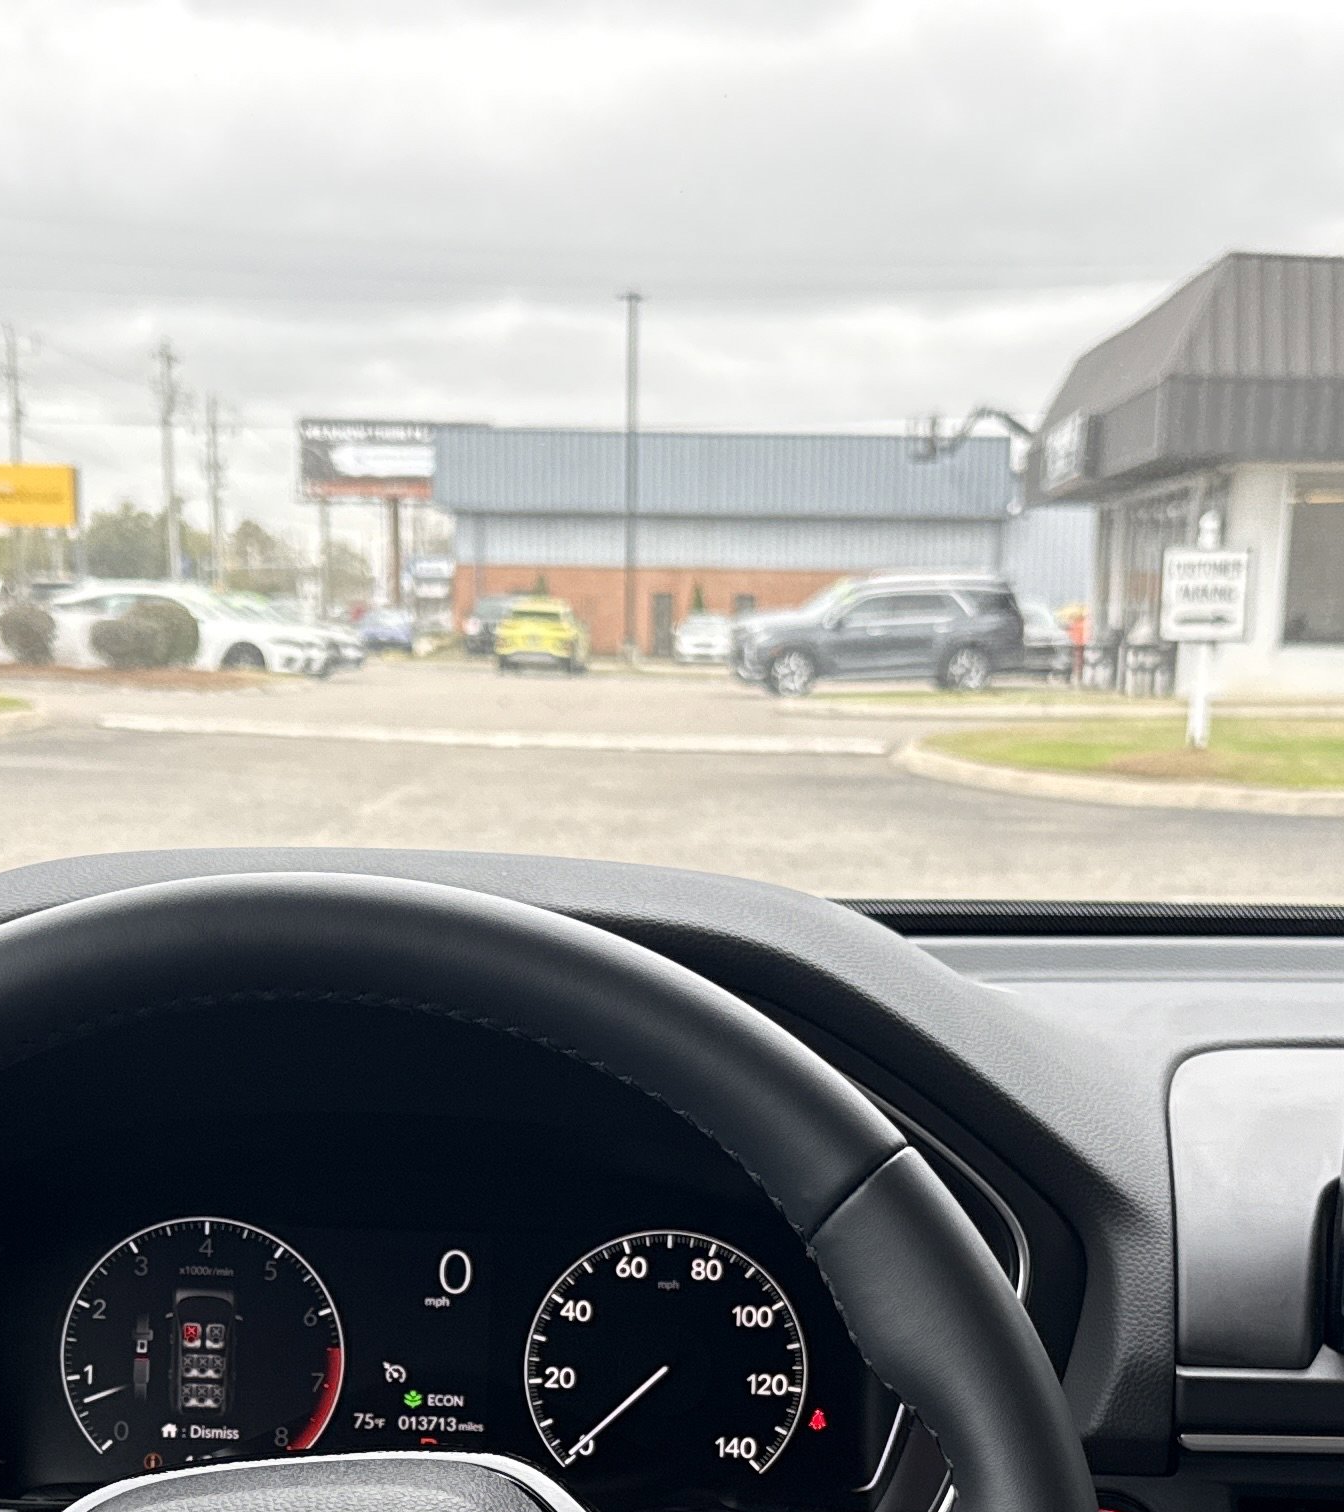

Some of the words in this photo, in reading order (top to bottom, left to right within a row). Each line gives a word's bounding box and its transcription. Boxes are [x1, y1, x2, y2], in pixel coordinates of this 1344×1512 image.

[198, 1238, 213, 1258] 4
[134, 1258, 149, 1276] 3
[264, 1261, 278, 1281] 5
[439, 1250, 472, 1294] 0
[616, 1258, 648, 1279] 60
[691, 1258, 723, 1281] 80
[92, 1300, 107, 1319] 2
[424, 1297, 450, 1310] mph
[560, 1300, 592, 1323] 40
[303, 1307, 318, 1326] 6
[732, 1305, 774, 1329] 100
[83, 1365, 94, 1384] 1
[311, 1373, 325, 1392] 7
[545, 1367, 576, 1389] 20
[747, 1374, 789, 1396] 120
[427, 1394, 464, 1407] ECON
[113, 1421, 129, 1440] 0
[190, 1425, 239, 1440] Dismiss
[398, 1416, 457, 1432] 013713
[274, 1427, 289, 1446] 8
[715, 1437, 757, 1459] 140
